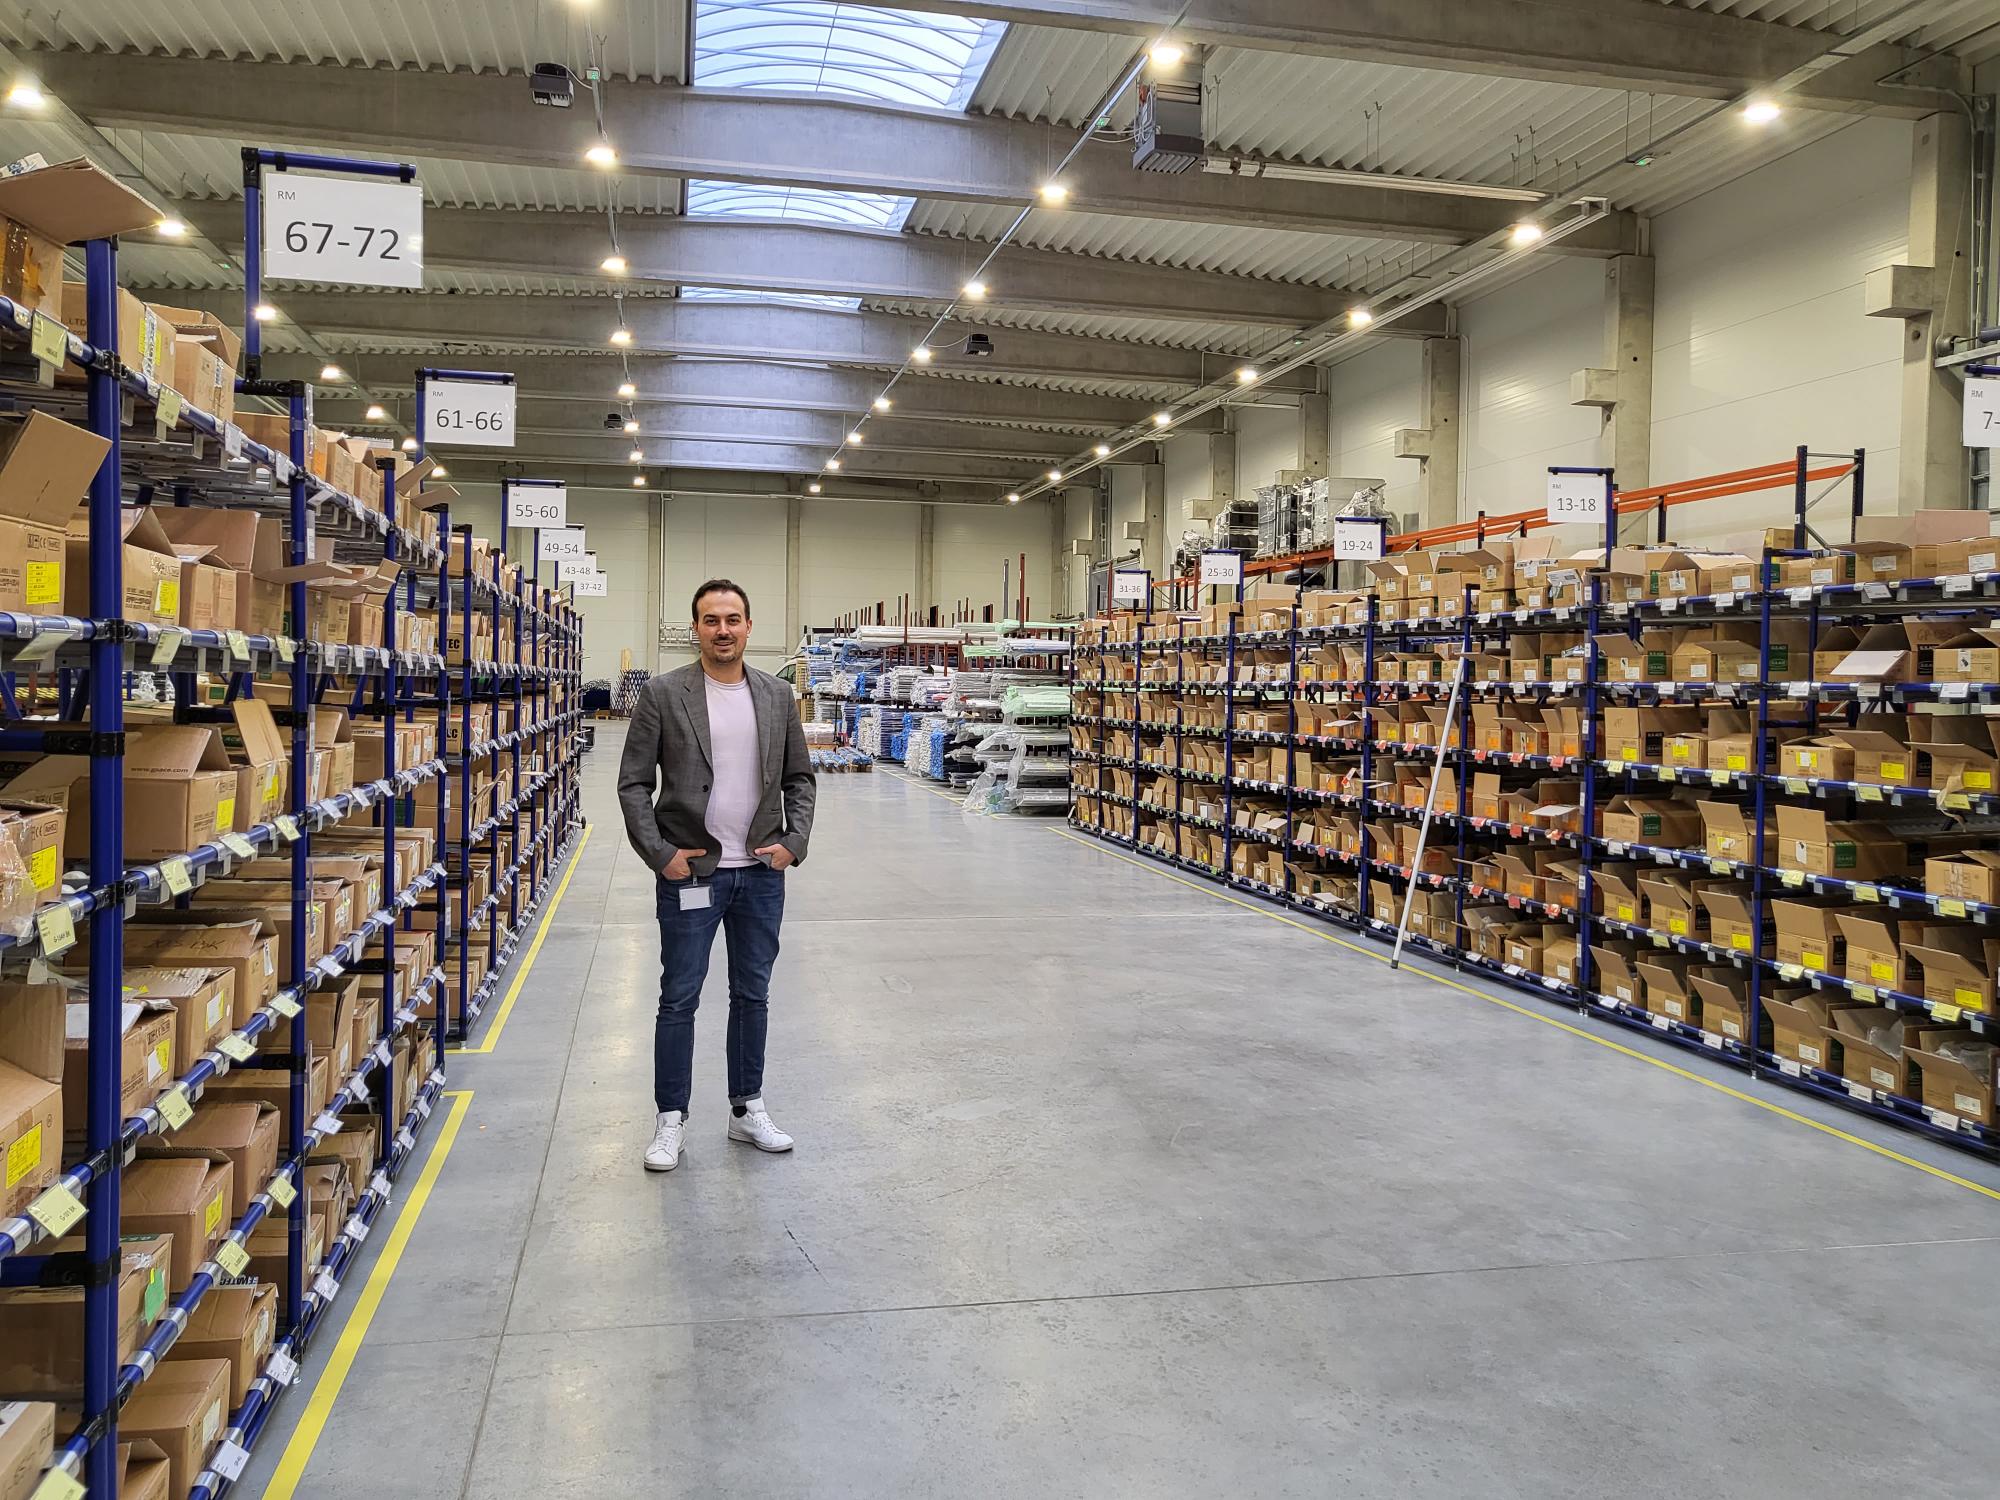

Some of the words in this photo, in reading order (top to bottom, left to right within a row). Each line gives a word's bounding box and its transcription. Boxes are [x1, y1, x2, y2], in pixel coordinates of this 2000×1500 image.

[277, 190, 296, 201] RM
[285, 220, 401, 261] 67-72
[436, 408, 503, 431] 61-66
[1557, 497, 1597, 512] 13-18
[515, 504, 559, 519] 55-60
[544, 542, 579, 554] 49-54
[1342, 540, 1374, 551] 19-24
[564, 566, 591, 576] 43-48
[1207, 567, 1234, 577] 25-30
[580, 583, 602, 591] 37-42
[1119, 585, 1141, 593] 31-36
